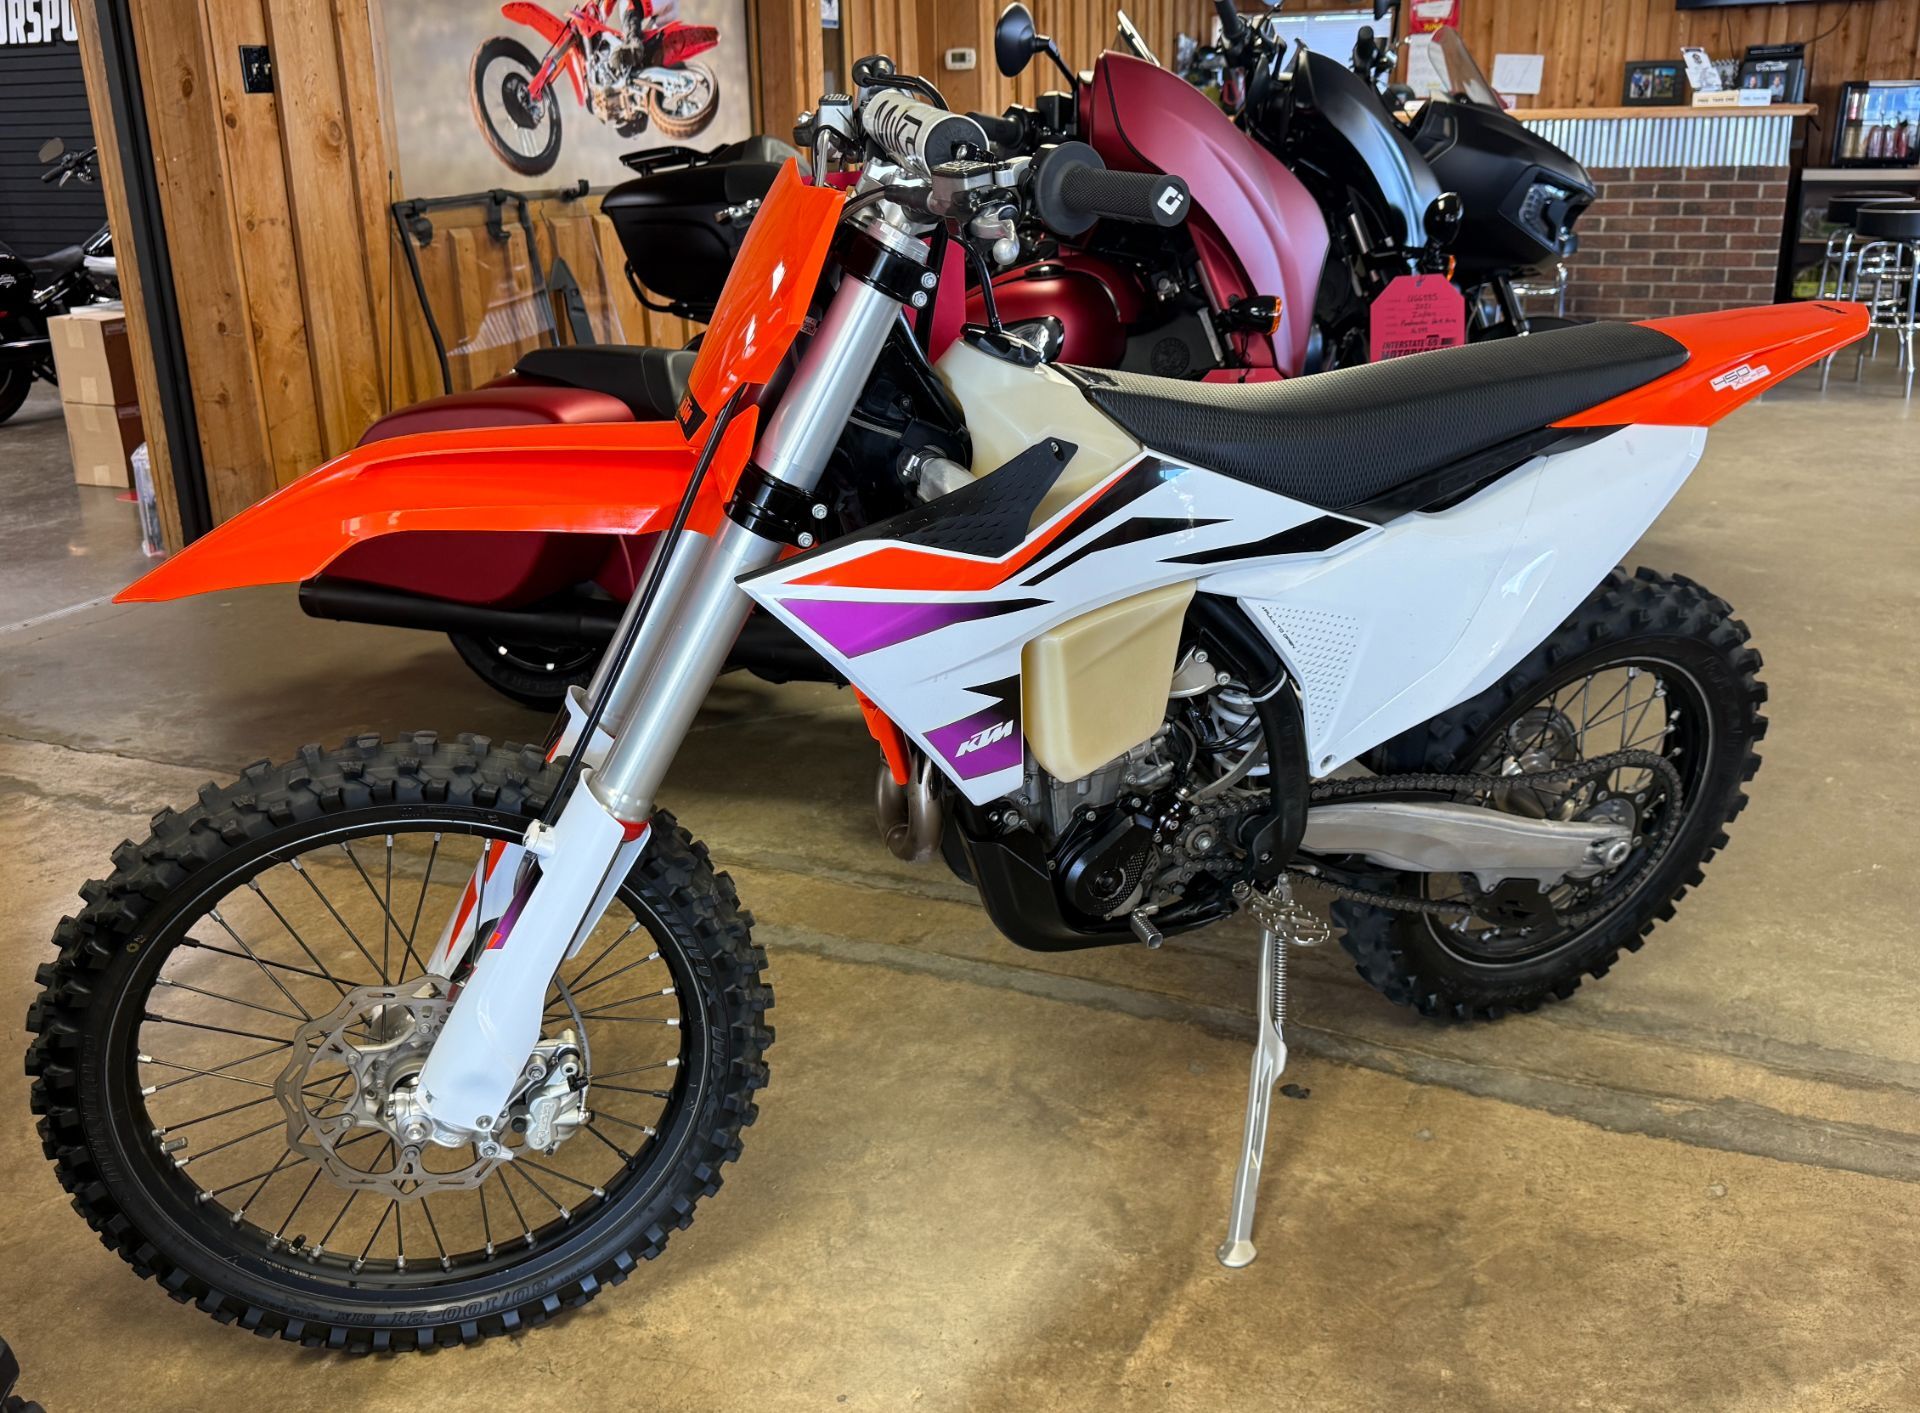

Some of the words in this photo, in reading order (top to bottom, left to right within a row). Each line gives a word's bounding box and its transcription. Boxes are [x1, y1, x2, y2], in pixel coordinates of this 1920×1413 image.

[1382, 339, 1425, 350] INTERSTATE
[1712, 366, 1751, 385] 450
[955, 719, 1014, 758] KTM
